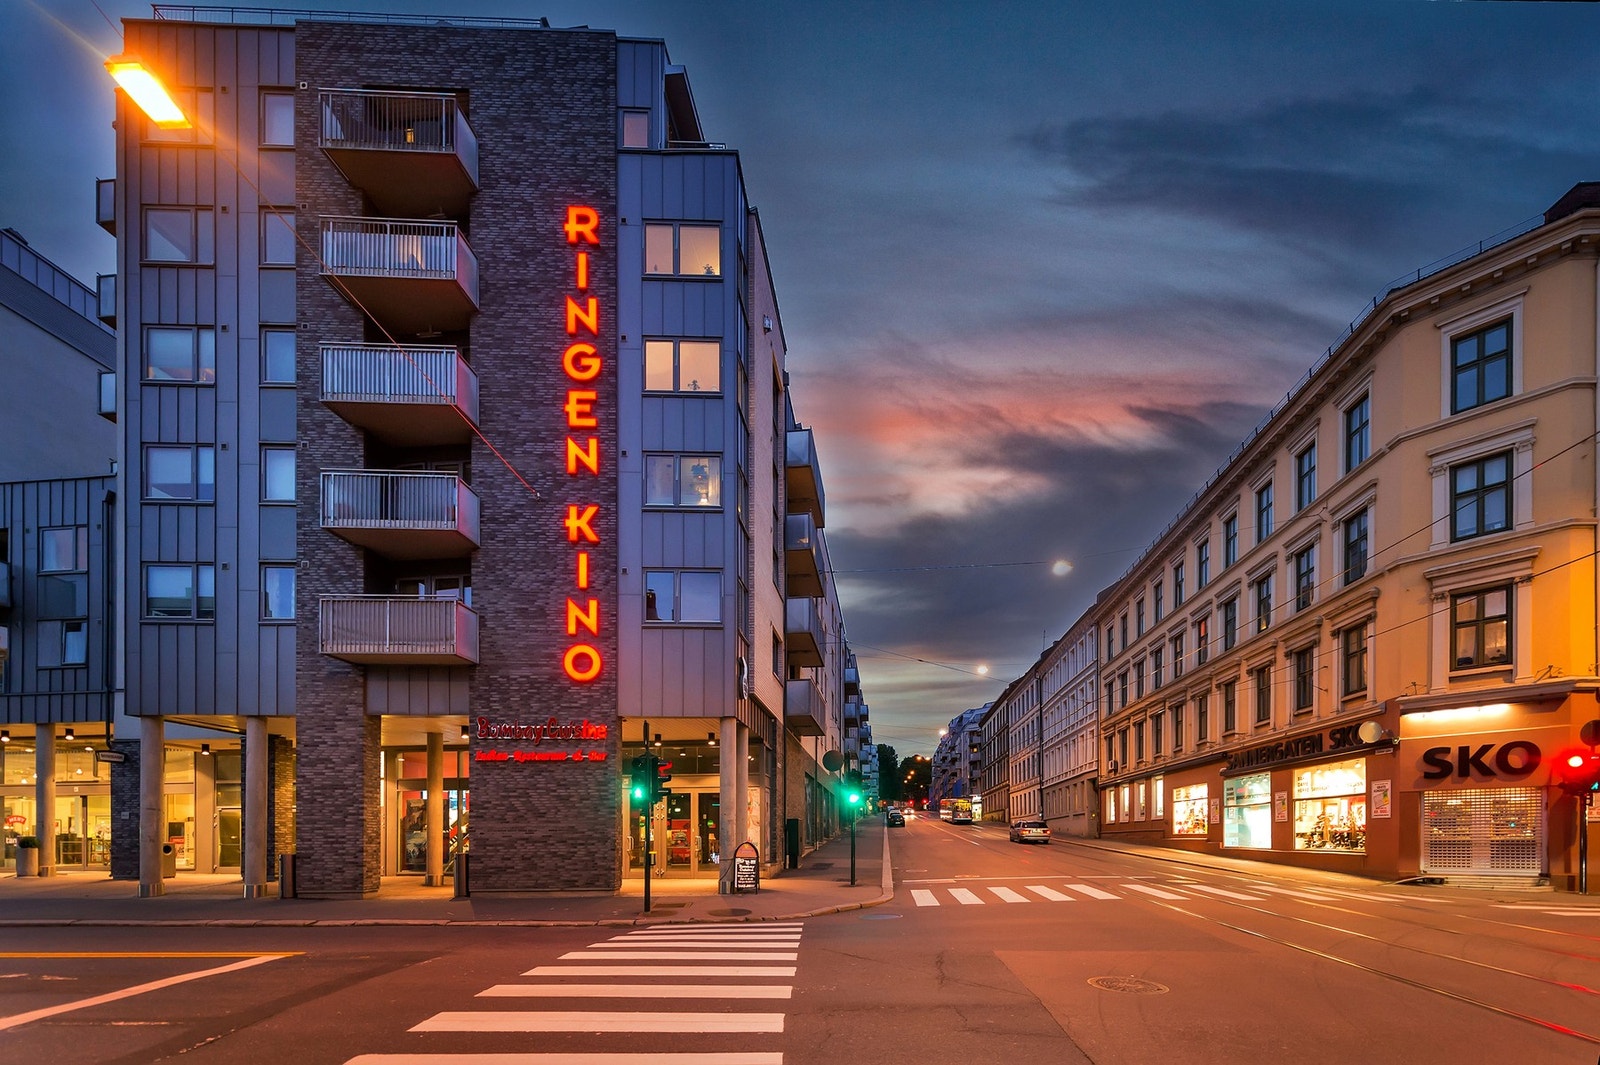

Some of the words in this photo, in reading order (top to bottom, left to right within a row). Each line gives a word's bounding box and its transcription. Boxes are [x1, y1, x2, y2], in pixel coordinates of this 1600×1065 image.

[562, 205, 603, 476] RINGEN
[563, 504, 602, 682] KINO
[476, 716, 544, 745] Bombay
[546, 716, 608, 741] Cuisine
[1423, 740, 1542, 779] SKO
